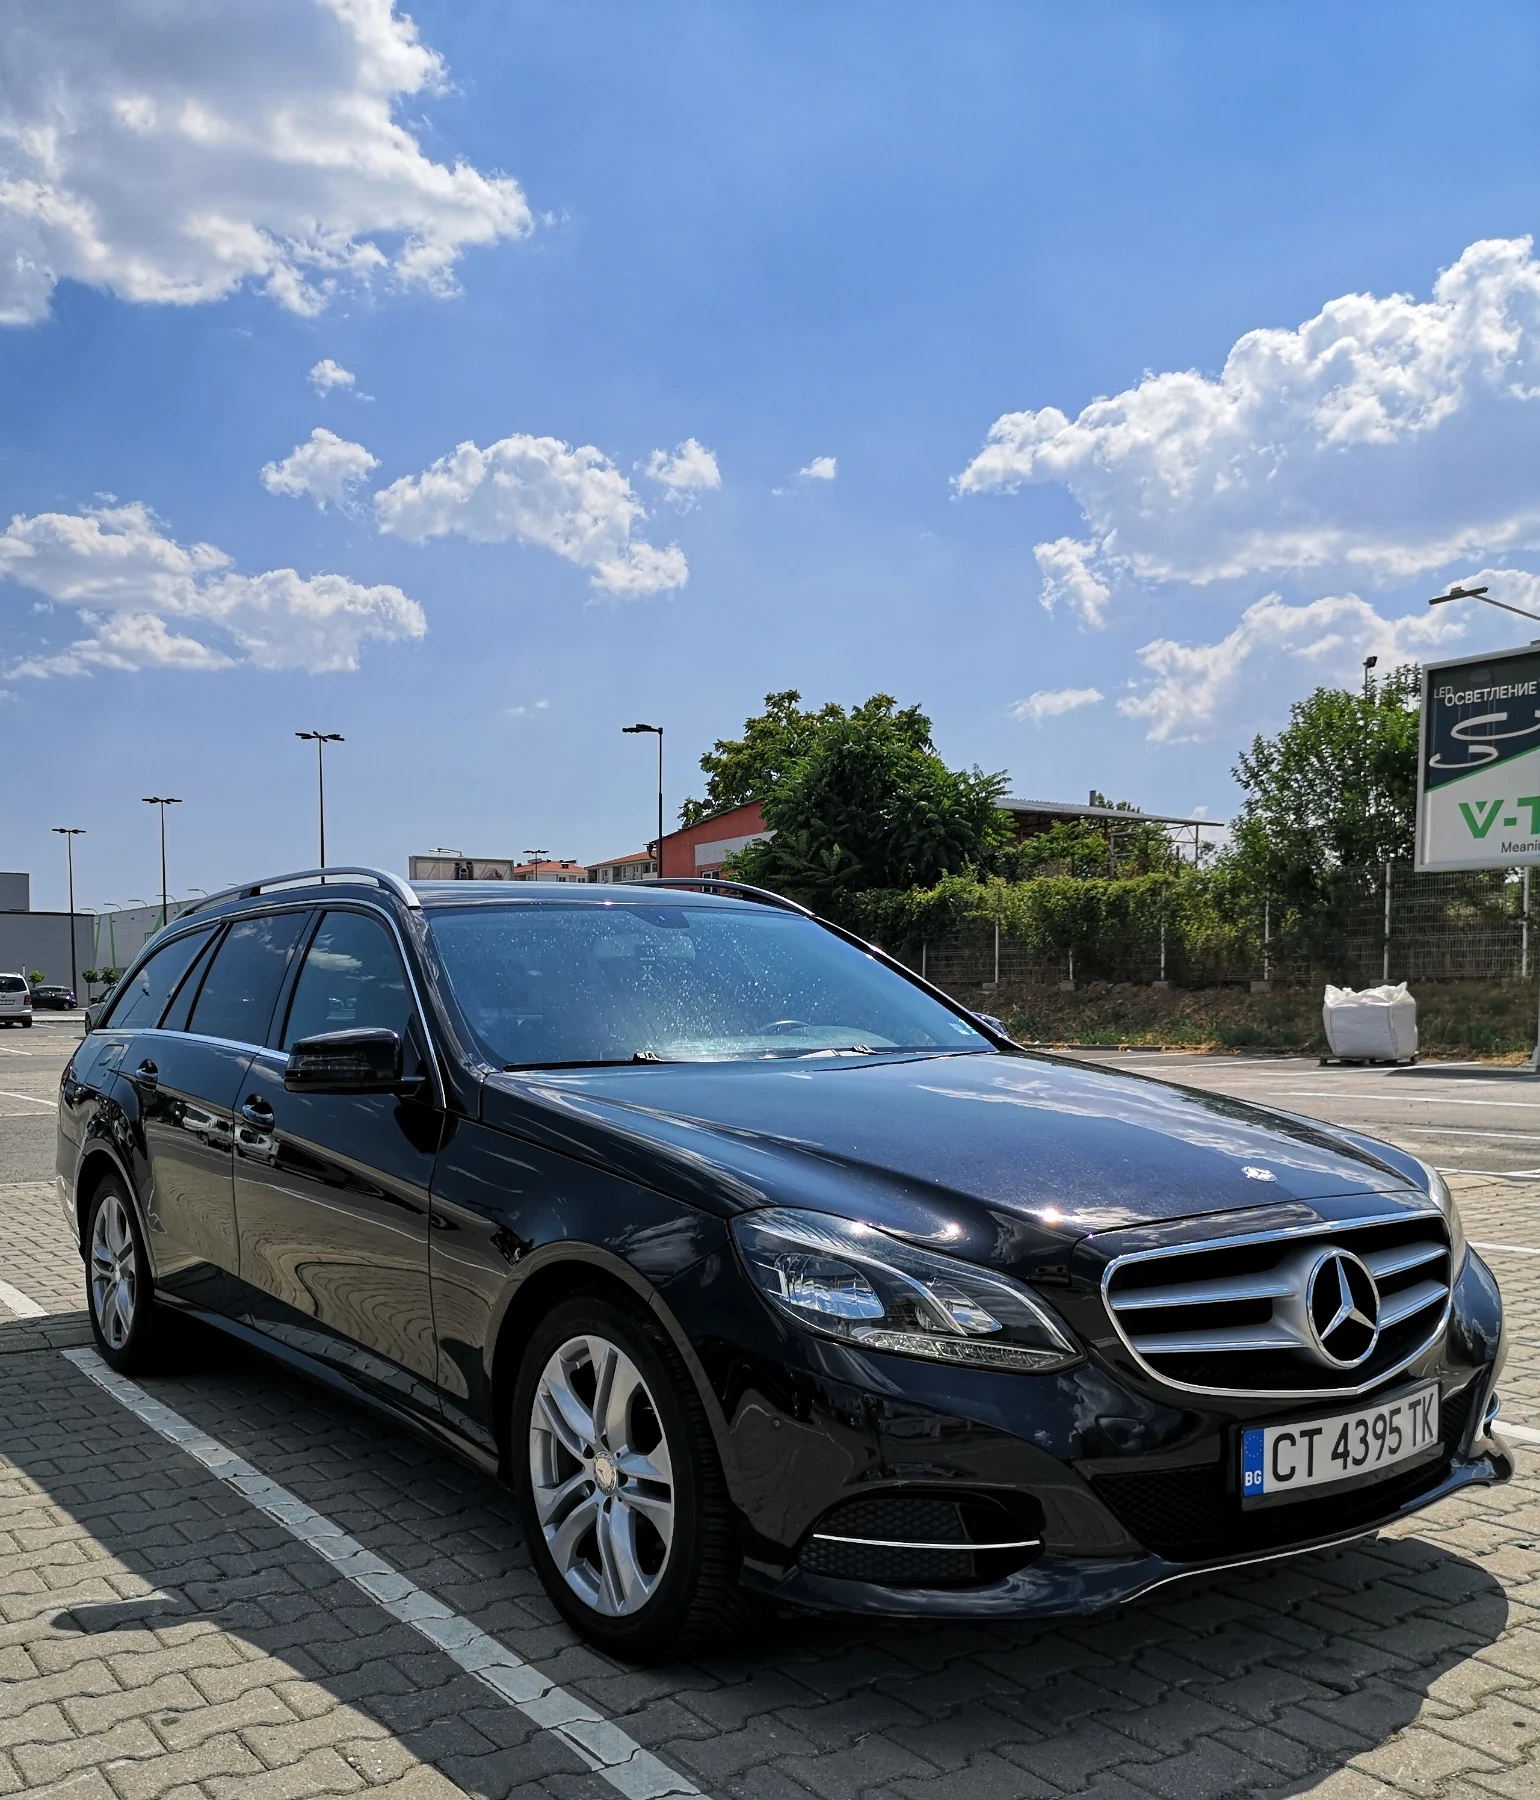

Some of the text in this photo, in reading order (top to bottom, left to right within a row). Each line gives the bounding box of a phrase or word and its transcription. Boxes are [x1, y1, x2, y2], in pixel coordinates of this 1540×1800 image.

[1434, 686, 1453, 699] LED
[1444, 681, 1538, 707] ОСВЕТЛЕНИЕ
[1501, 839, 1540, 853] Meani
[1272, 1392, 1434, 1482] CT 4395 TK
[1245, 1470, 1262, 1486] BG
